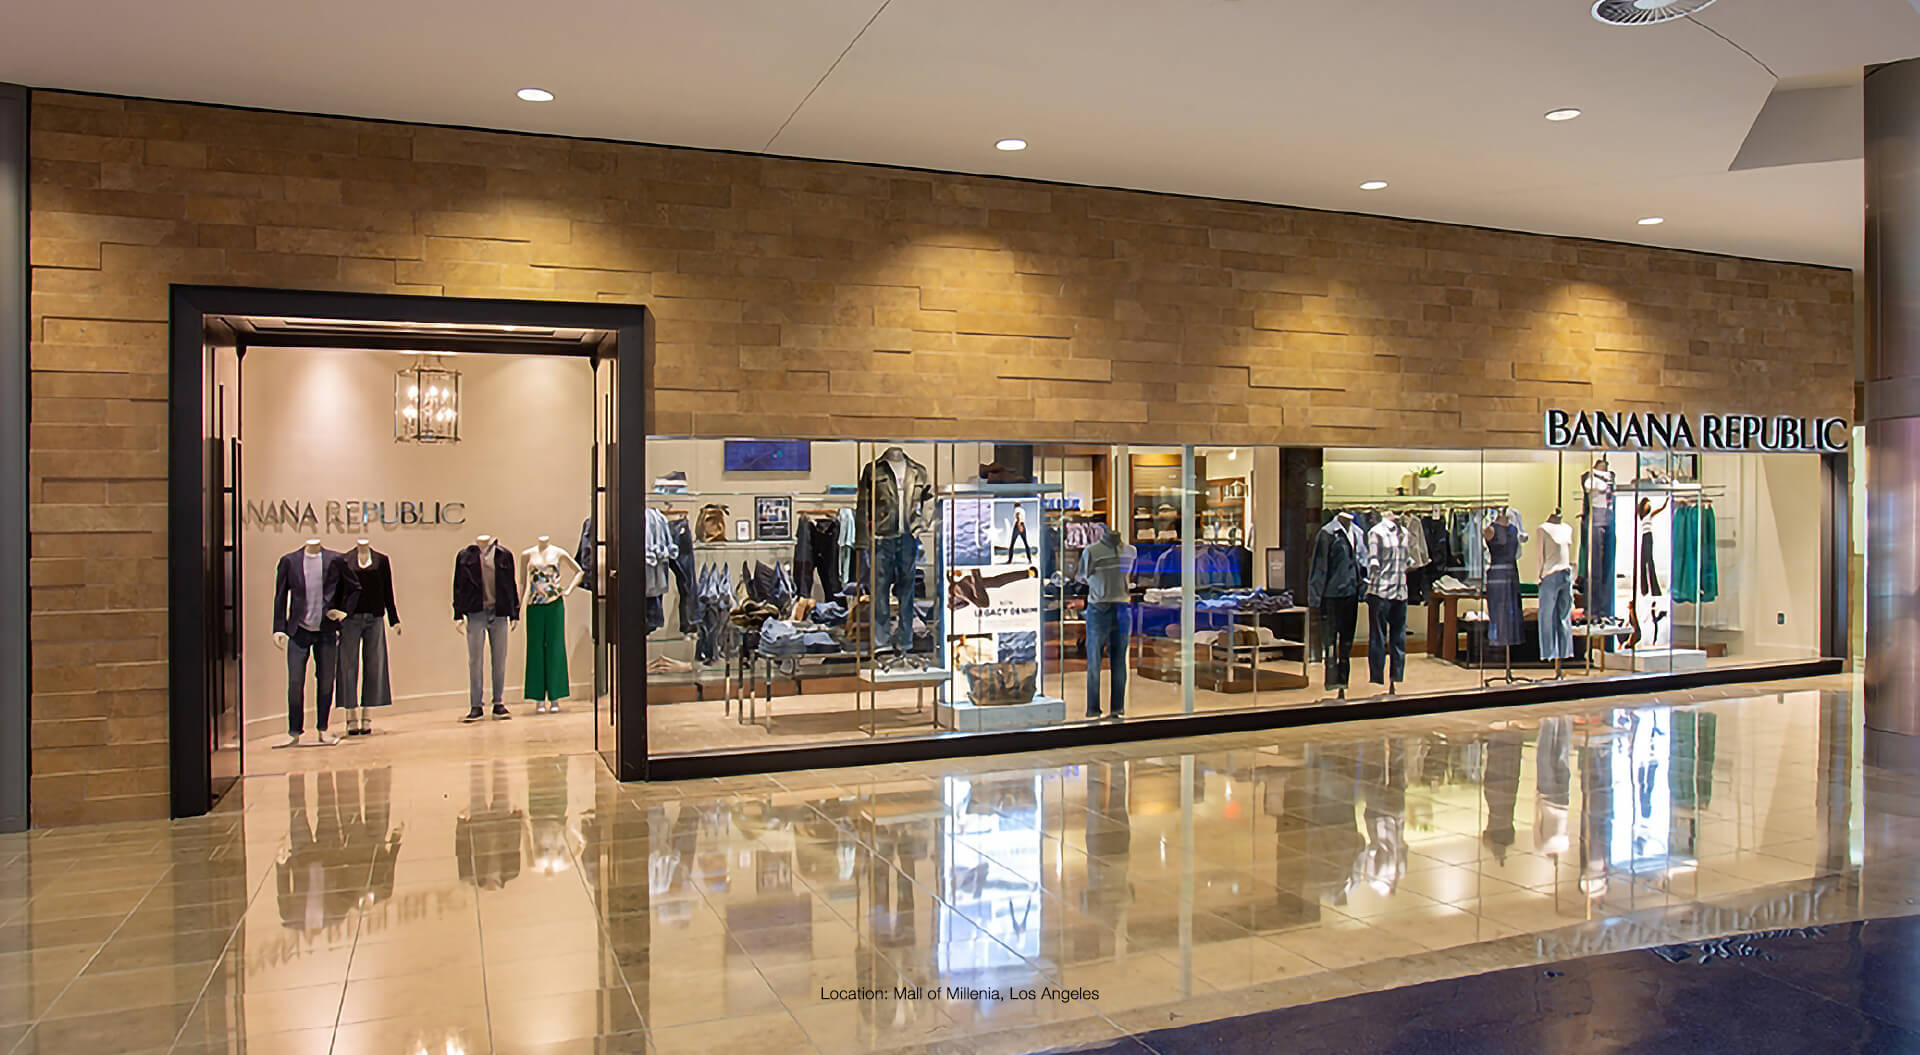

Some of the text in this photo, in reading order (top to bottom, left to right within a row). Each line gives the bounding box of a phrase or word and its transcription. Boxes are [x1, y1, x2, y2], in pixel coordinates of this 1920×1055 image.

[1548, 408, 1848, 450] BANANA REPUBLIC
[244, 500, 466, 527] NANA REPUBLIC
